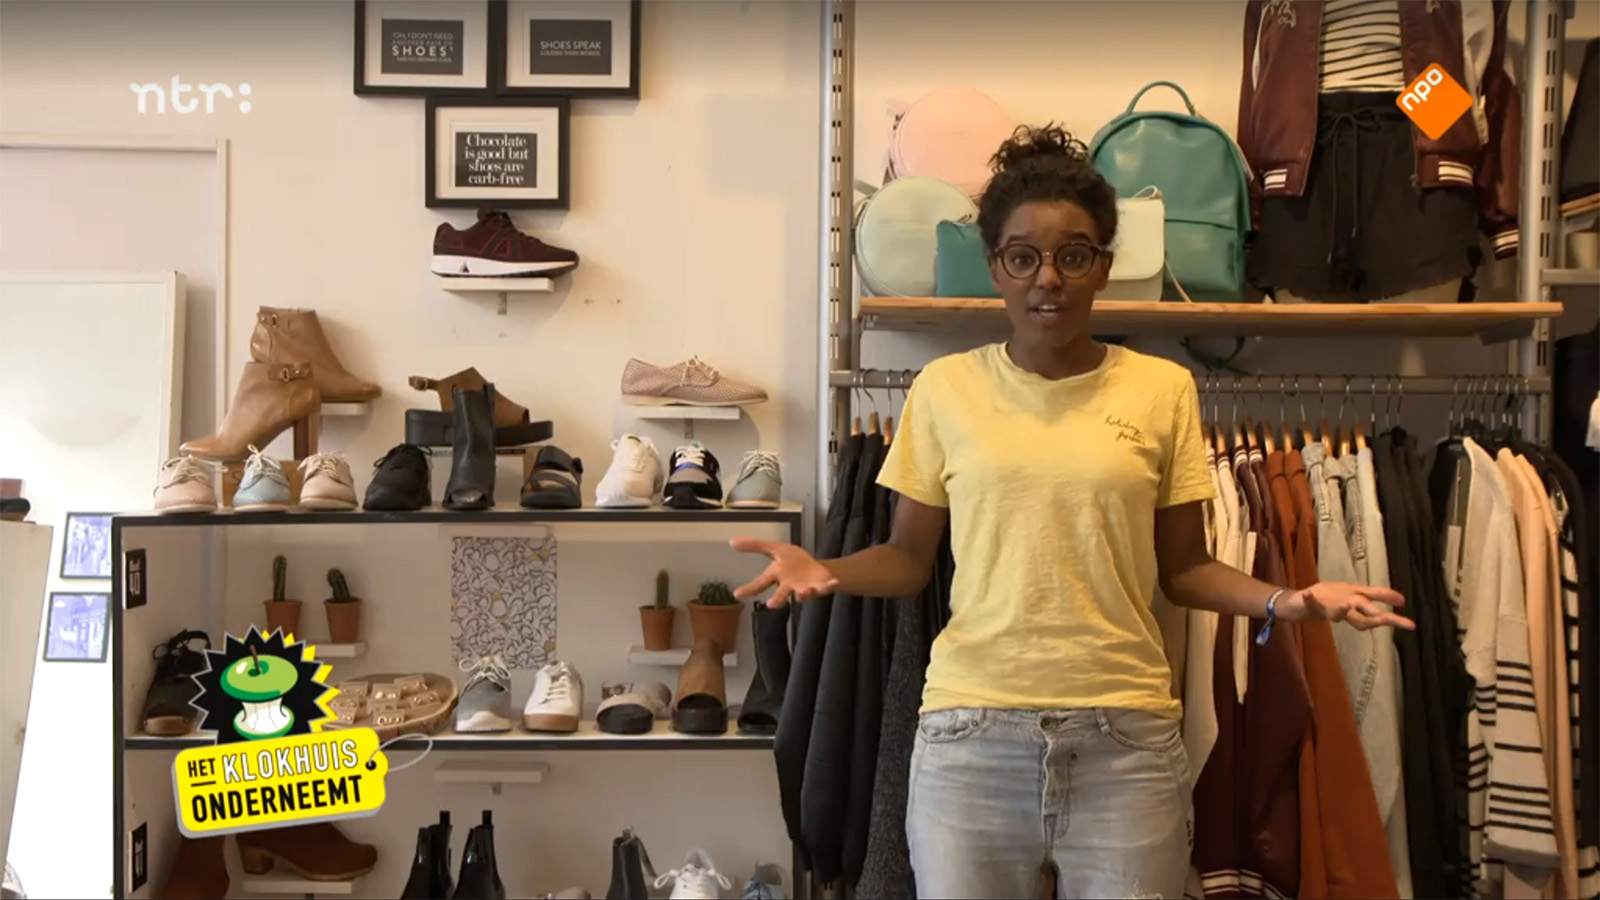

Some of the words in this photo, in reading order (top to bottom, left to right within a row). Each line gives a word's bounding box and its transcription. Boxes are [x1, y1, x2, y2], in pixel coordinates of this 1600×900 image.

[392, 45, 453, 57] SHOES'
[540, 40, 571, 50] SHOES
[572, 40, 602, 50] SPEAK
[466, 133, 527, 147] Chocolate
[465, 146, 475, 160] is
[476, 147, 505, 162] good
[508, 147, 528, 160] but
[468, 157, 502, 172] shoes
[503, 162, 525, 172] are
[468, 172, 525, 185] carb-free
